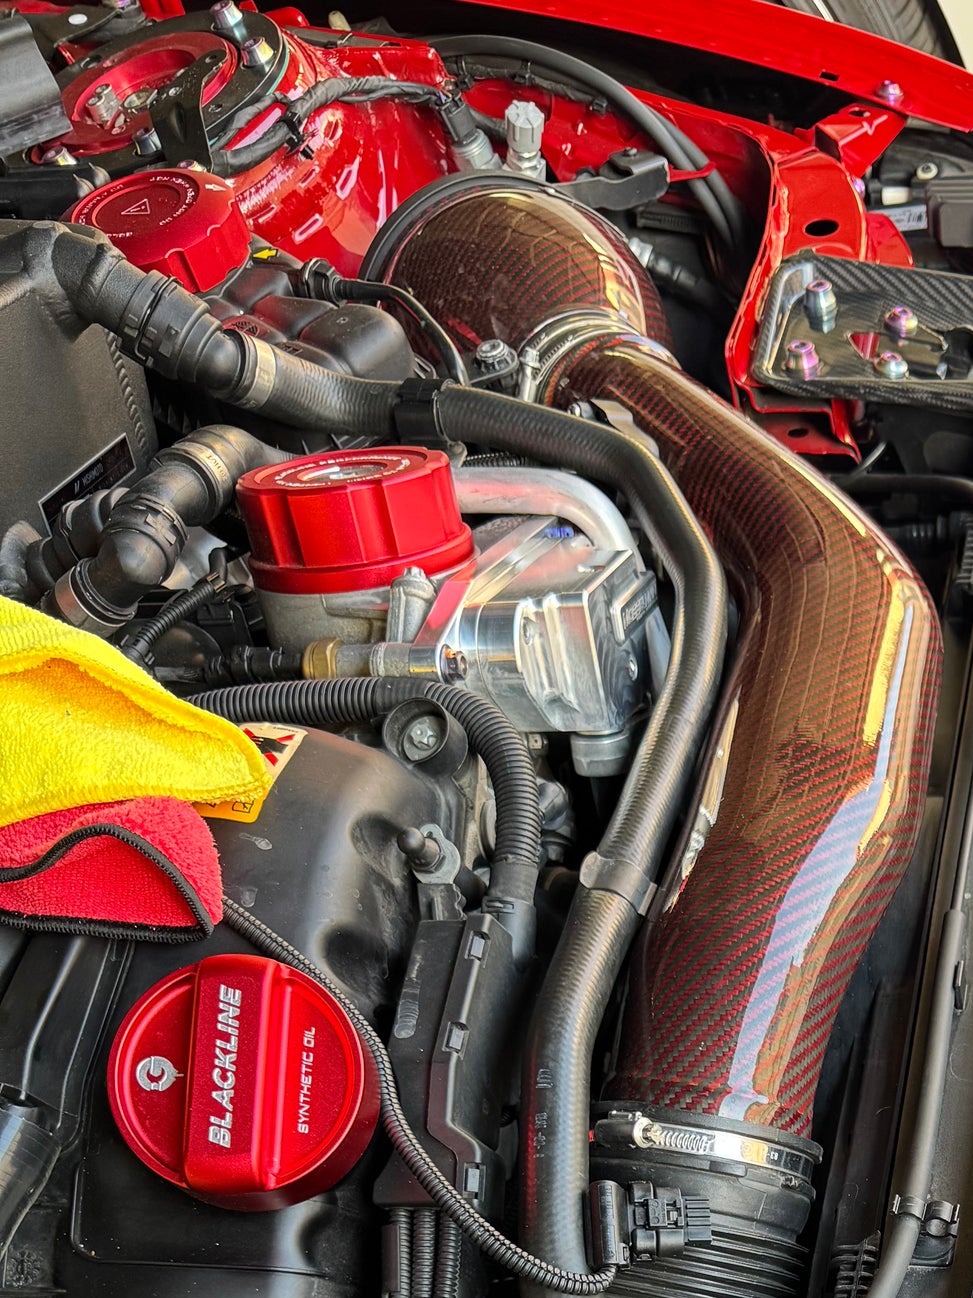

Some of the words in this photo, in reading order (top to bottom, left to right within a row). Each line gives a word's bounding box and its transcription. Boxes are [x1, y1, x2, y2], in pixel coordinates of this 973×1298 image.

[207, 984, 243, 1148] BLACKLINE
[303, 1026, 317, 1049] OIL
[297, 1051, 315, 1135] SYNTHETIC
